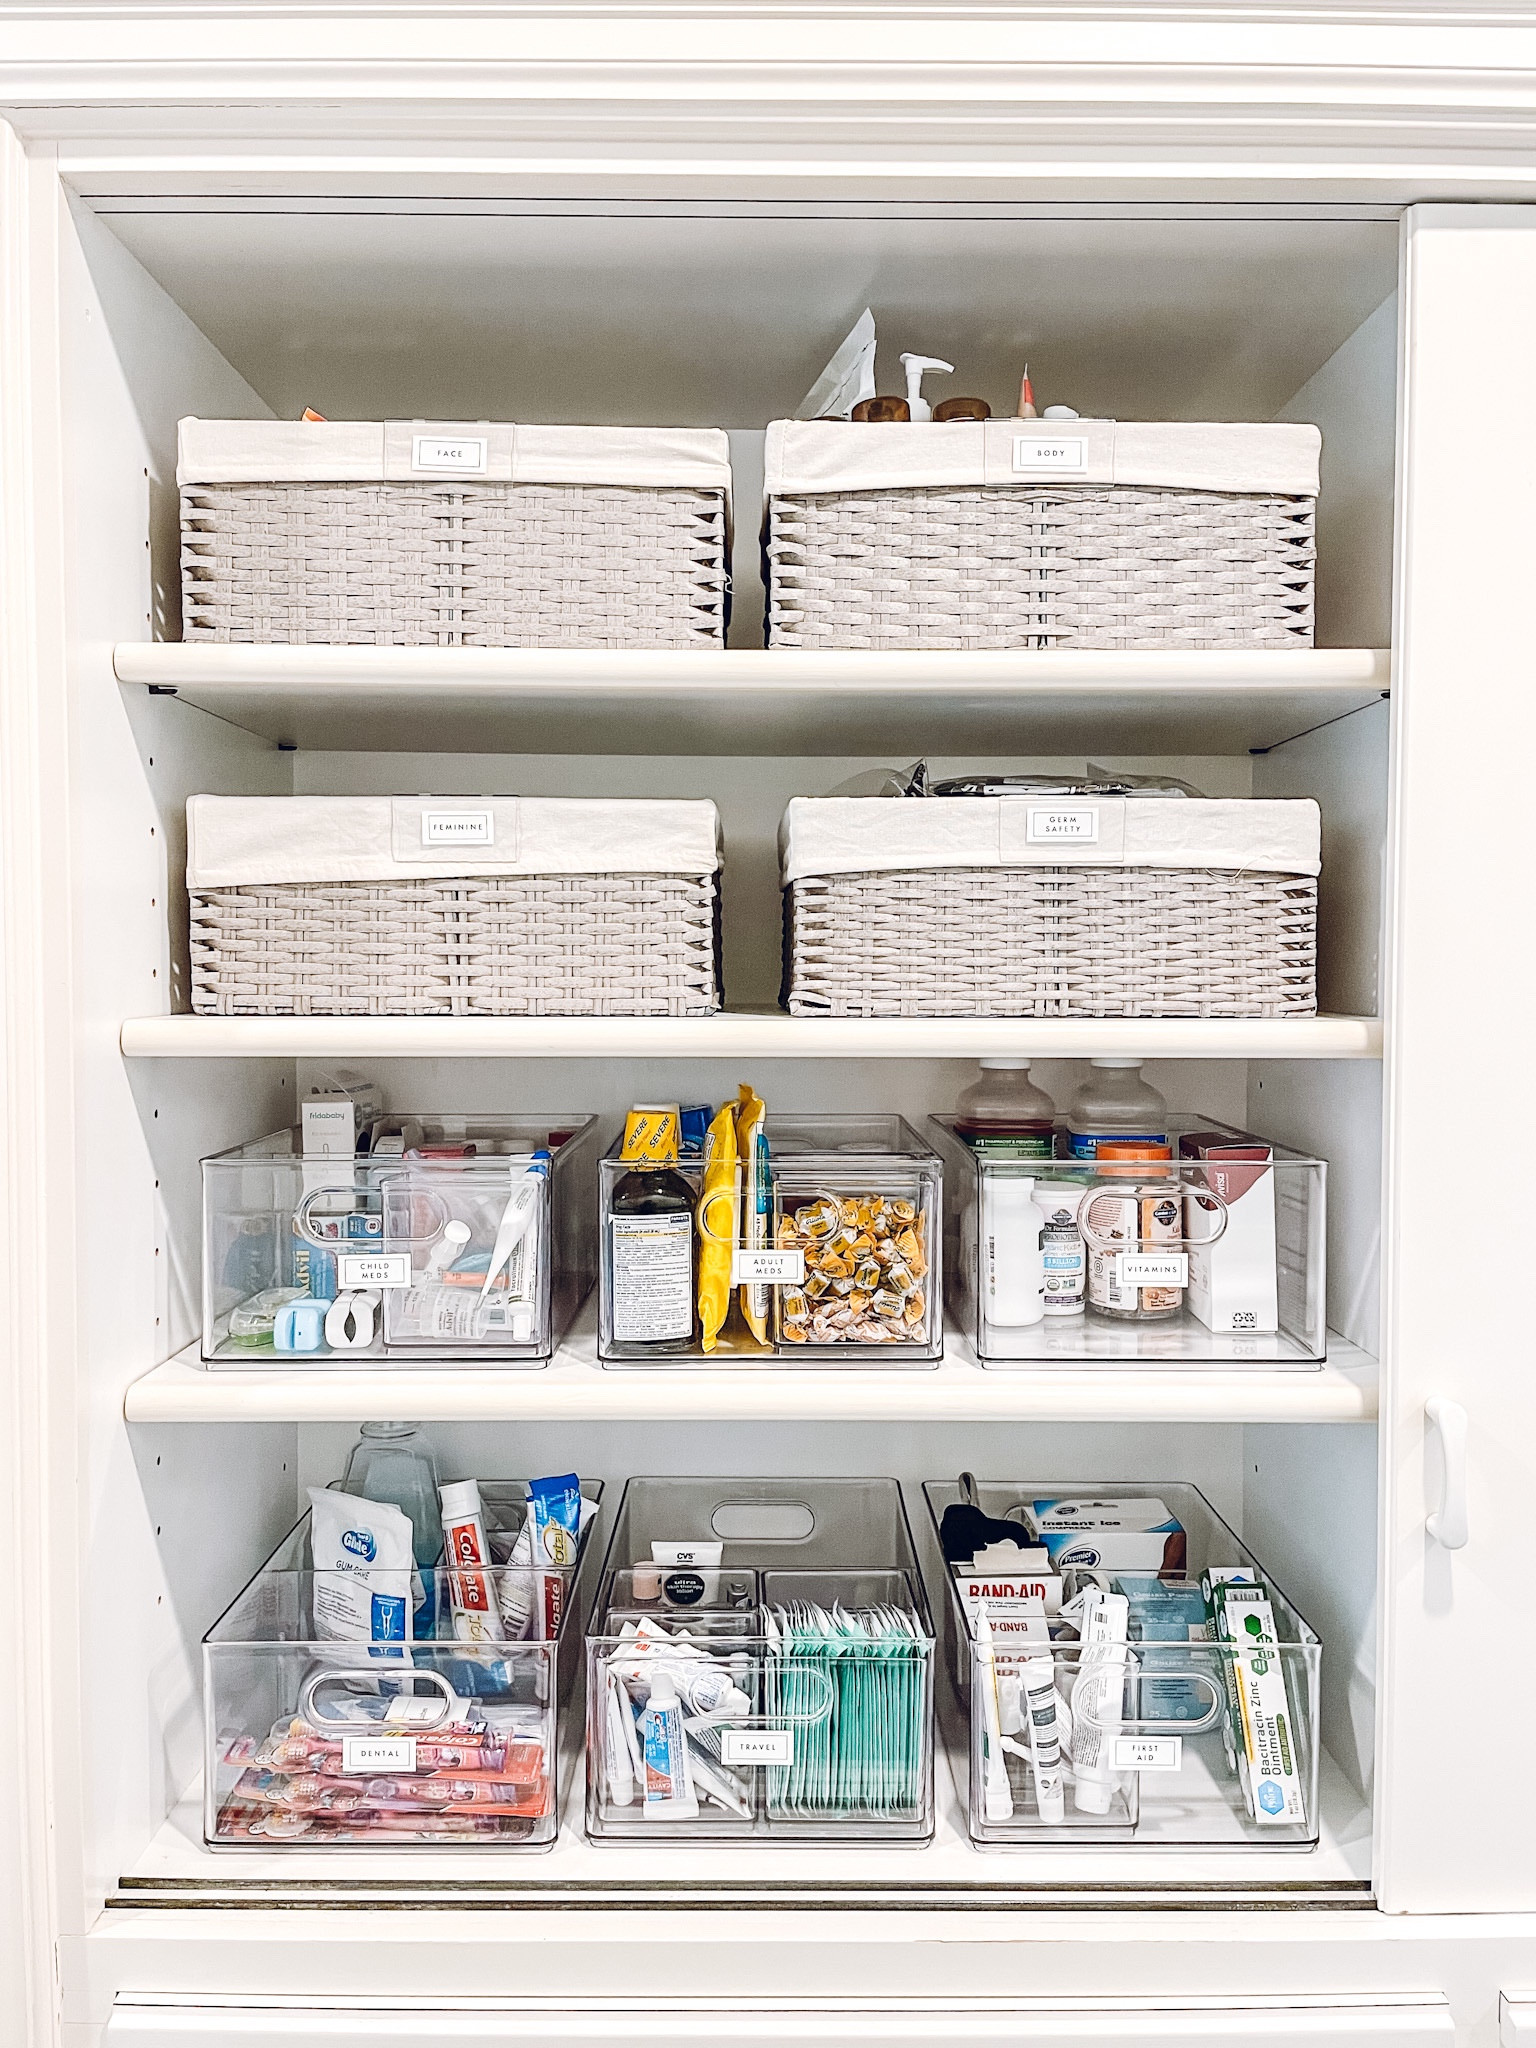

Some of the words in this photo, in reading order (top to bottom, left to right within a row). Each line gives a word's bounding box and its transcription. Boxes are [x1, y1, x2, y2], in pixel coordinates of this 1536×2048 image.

[437, 449, 463, 458] FACE
[1037, 449, 1065, 457] BODY
[433, 823, 483, 831] FEMININE
[1045, 825, 1081, 833] SAFETY
[627, 1116, 649, 1150] SEVERE
[649, 1114, 671, 1149] SEVERE
[359, 1262, 390, 1270] CHILD
[753, 1257, 785, 1266] ADULT
[361, 1271, 389, 1279] MEDS
[755, 1267, 783, 1275] MEDS
[343, 1532, 368, 1554] Glide
[676, 1552, 694, 1560] CVS
[1065, 1551, 1092, 1563] Premier
[336, 1560, 353, 1571] GUM
[969, 1583, 1046, 1601] BAND-AID
[1249, 1681, 1261, 1707] Zinc
[739, 1743, 776, 1751] TRAVEL
[1253, 1710, 1271, 1775] Bacitracin
[1265, 1716, 1282, 1776] Ointment
[1132, 1744, 1158, 1752] FIRST
[360, 1749, 400, 1757] DENTAL
